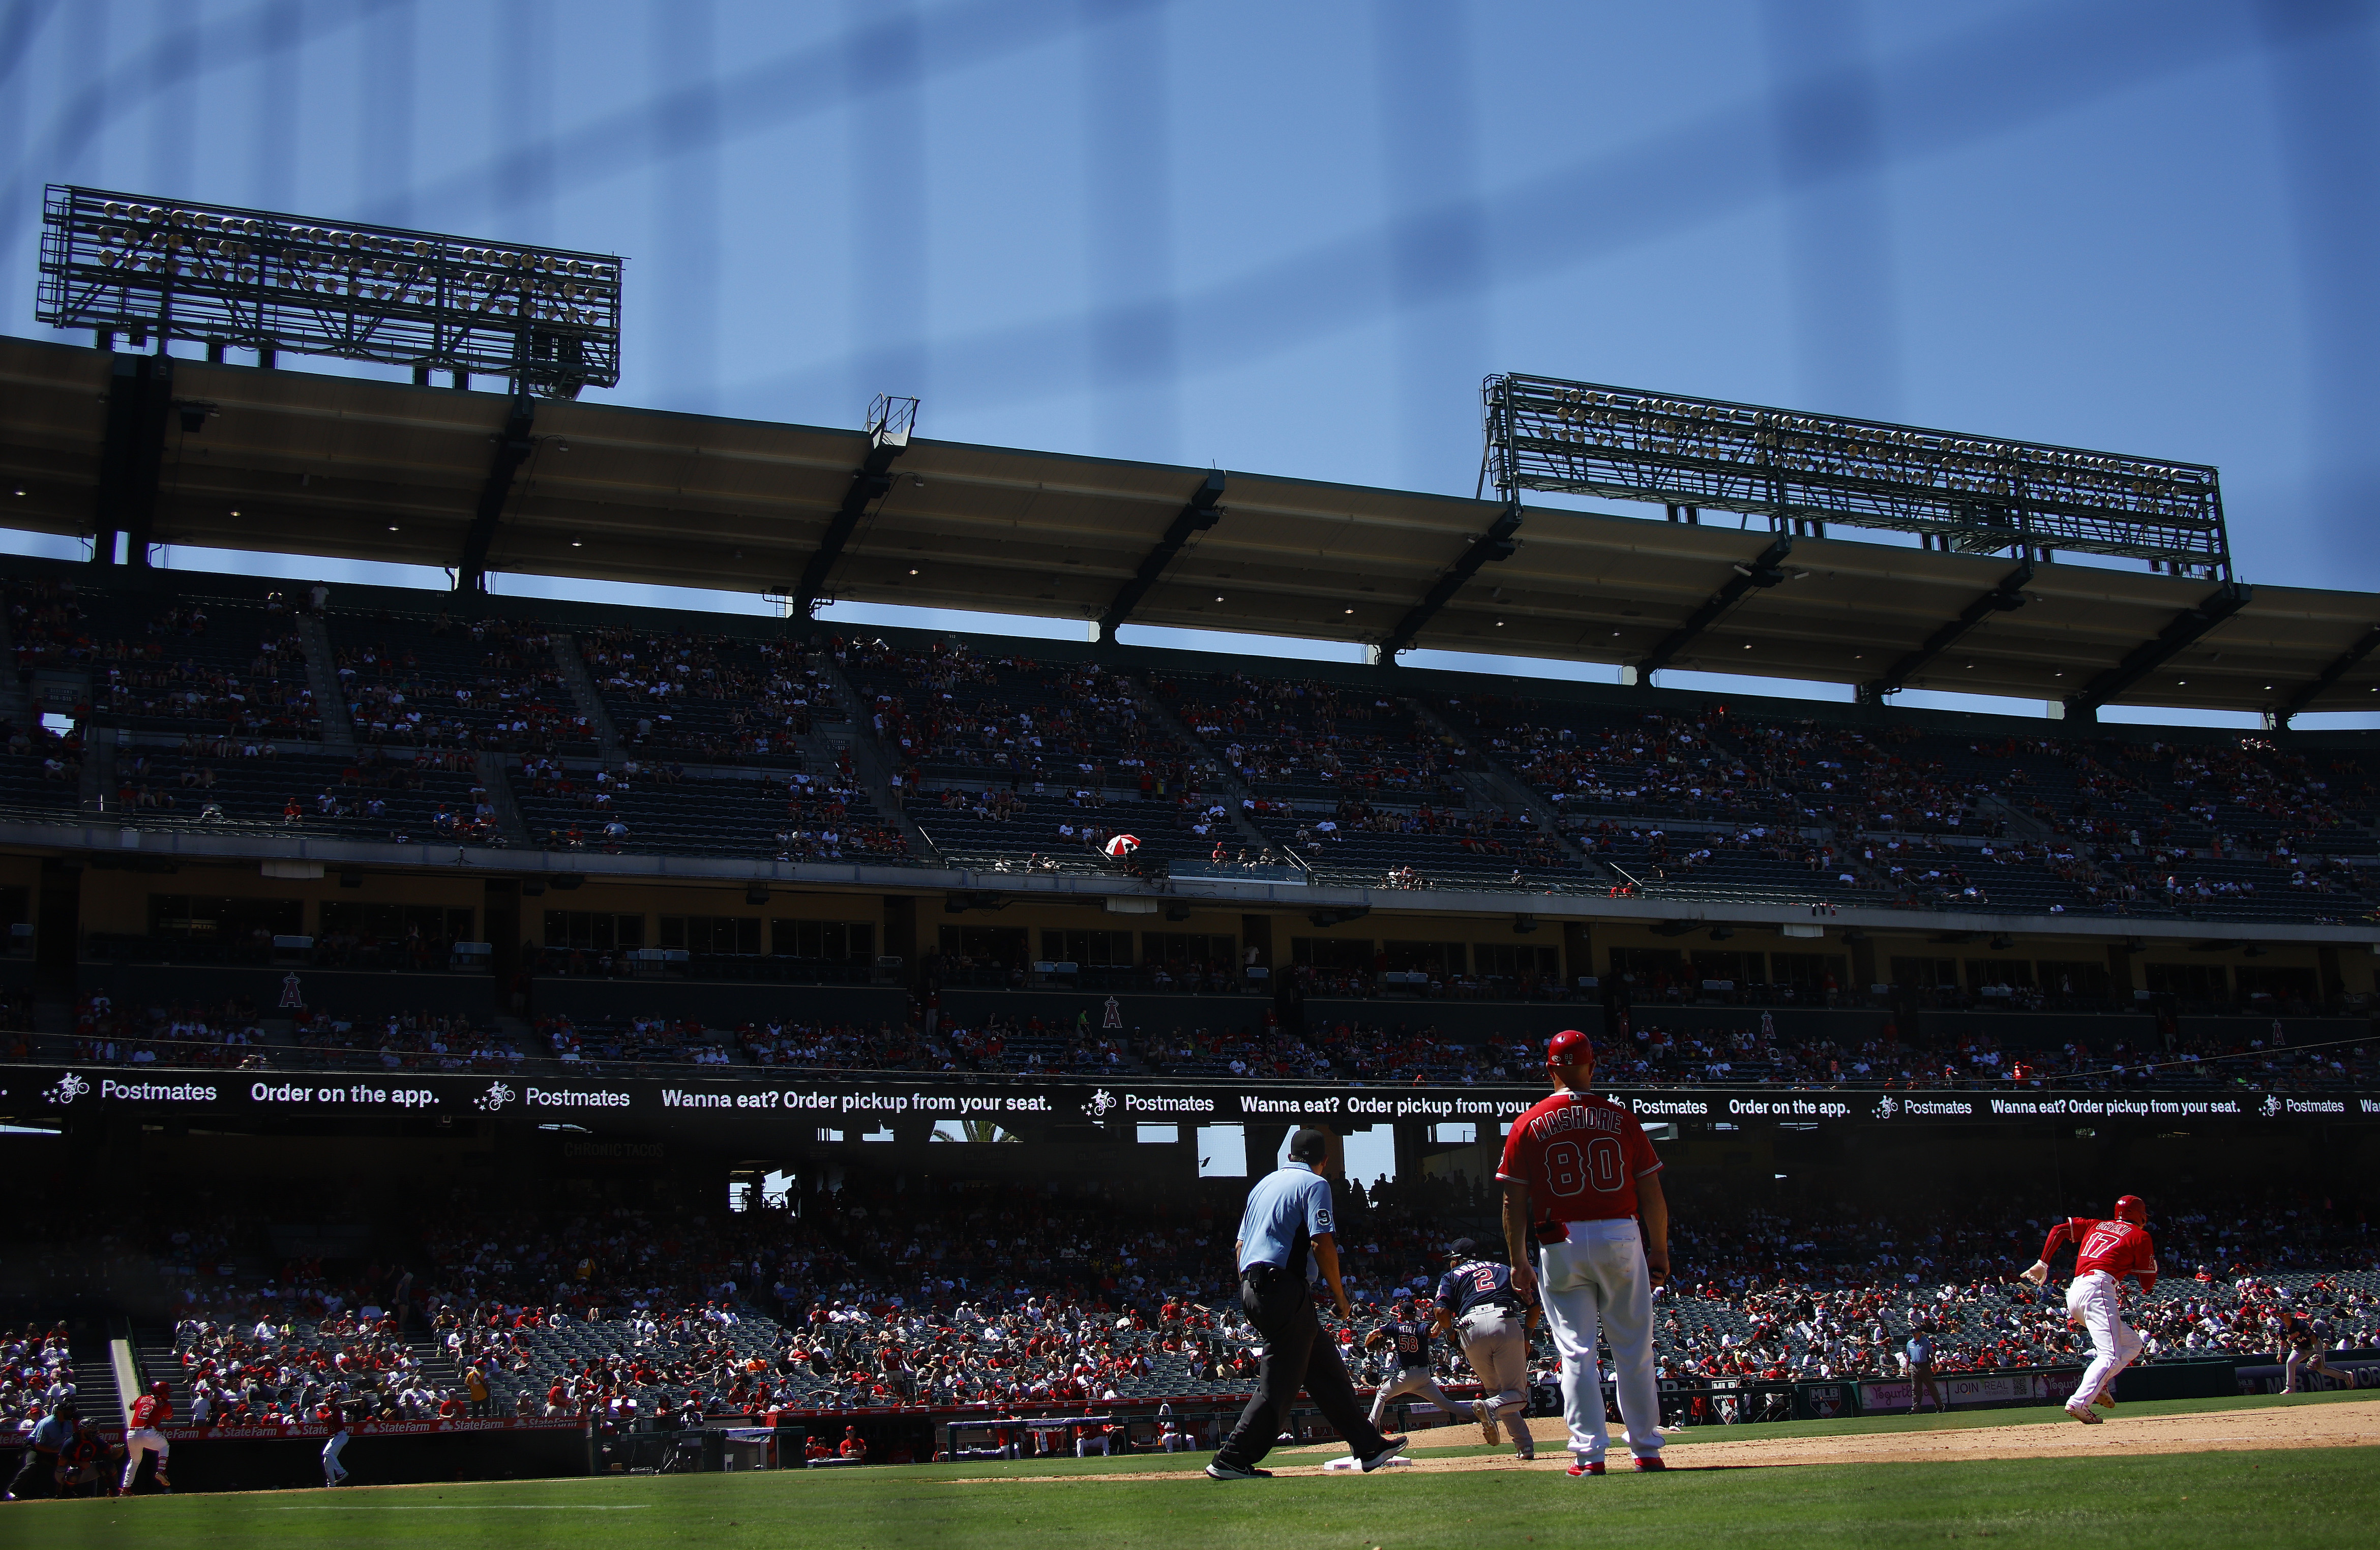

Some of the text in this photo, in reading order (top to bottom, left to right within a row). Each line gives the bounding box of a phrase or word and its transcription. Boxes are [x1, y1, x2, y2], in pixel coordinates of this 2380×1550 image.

[102, 1080, 217, 1100] Postmates
[252, 1083, 440, 1108] Order on the app.
[526, 1087, 630, 1107] Postmates
[662, 1089, 1052, 1114] Wanna eat? Order pickup from your seat.
[1126, 1094, 1214, 1111] Postmates
[1241, 1096, 1530, 1117] Wanna eat? Order pickup from your
[1633, 1099, 1707, 1114] Postmates
[1730, 1099, 1851, 1117] Order on the app.
[1905, 1099, 1972, 1114] Postmates
[1991, 1099, 2241, 1116] Wanna eat? Order pickup from your seat.
[2286, 1098, 2344, 1112] Postmates
[1530, 1106, 1623, 1142] MASHORE
[564, 1142, 664, 1157] CHRONIC TACOS
[1544, 1137, 1625, 1197] 80
[1317, 1208, 1331, 1226] 9
[2096, 1222, 2132, 1236] OHTANI
[2080, 1232, 2120, 1258] 17
[1453, 1261, 1501, 1276] ARRAEZ
[1473, 1268, 1496, 1292] 2
[1399, 1335, 1418, 1353] 58
[1810, 1388, 1839, 1398] MLB
[1955, 1380, 2008, 1393] JOIN REAL
[138, 1404, 154, 1419] 2
